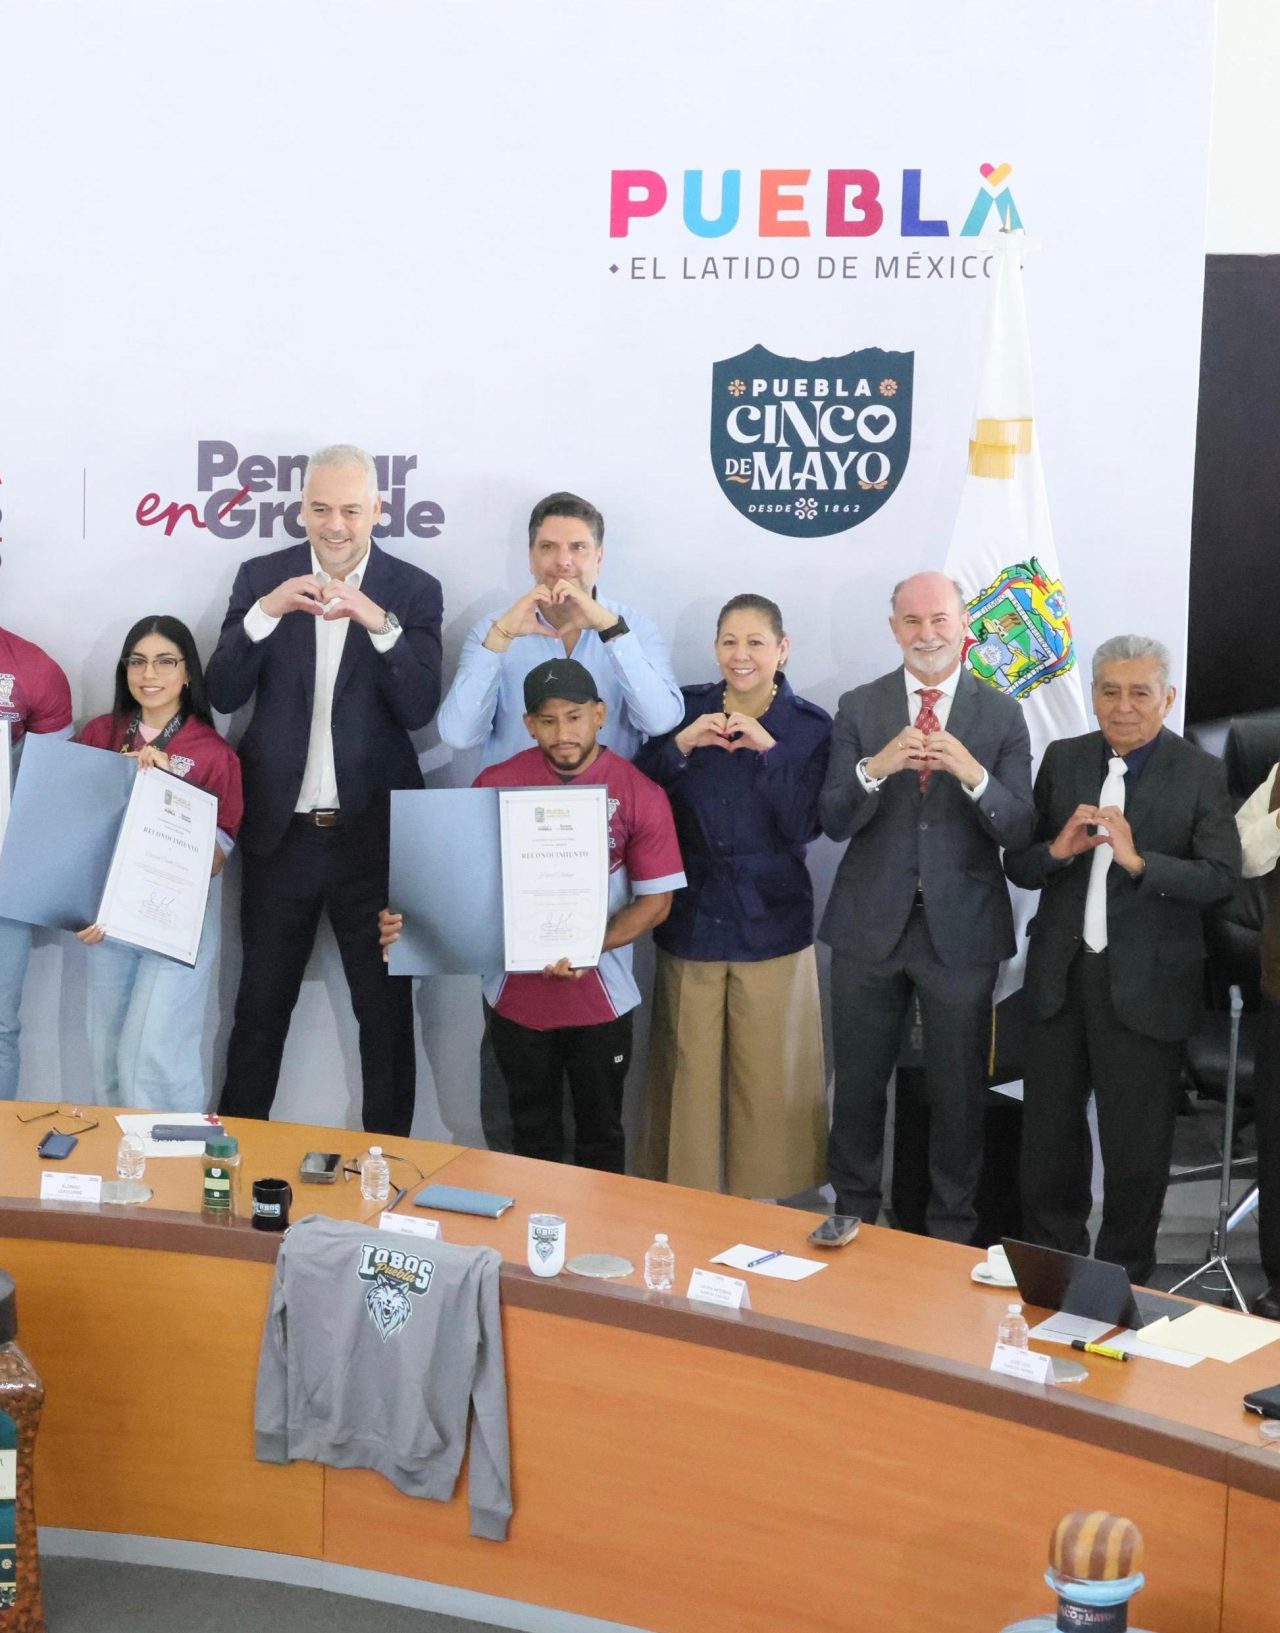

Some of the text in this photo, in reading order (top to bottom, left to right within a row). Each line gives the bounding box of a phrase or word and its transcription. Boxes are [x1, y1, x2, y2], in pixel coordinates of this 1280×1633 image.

[609, 163, 1025, 238] PUEBLA
[630, 256, 666, 280] EL
[682, 255, 801, 280] LATIDO
[818, 255, 858, 279] DE
[752, 378, 872, 397] PUEBLA
[726, 401, 897, 447] CINCO
[197, 440, 417, 493] Penr
[725, 451, 891, 490] DE MAYO
[136, 486, 445, 540] en Grade
[748, 504, 861, 513] DESDE 1862
[521, 851, 589, 859] RECONOCIMIENTO
[255, 1202, 280, 1215] LOBOS
[359, 1245, 434, 1291] LOBOS
[375, 1263, 417, 1283] Puebla
